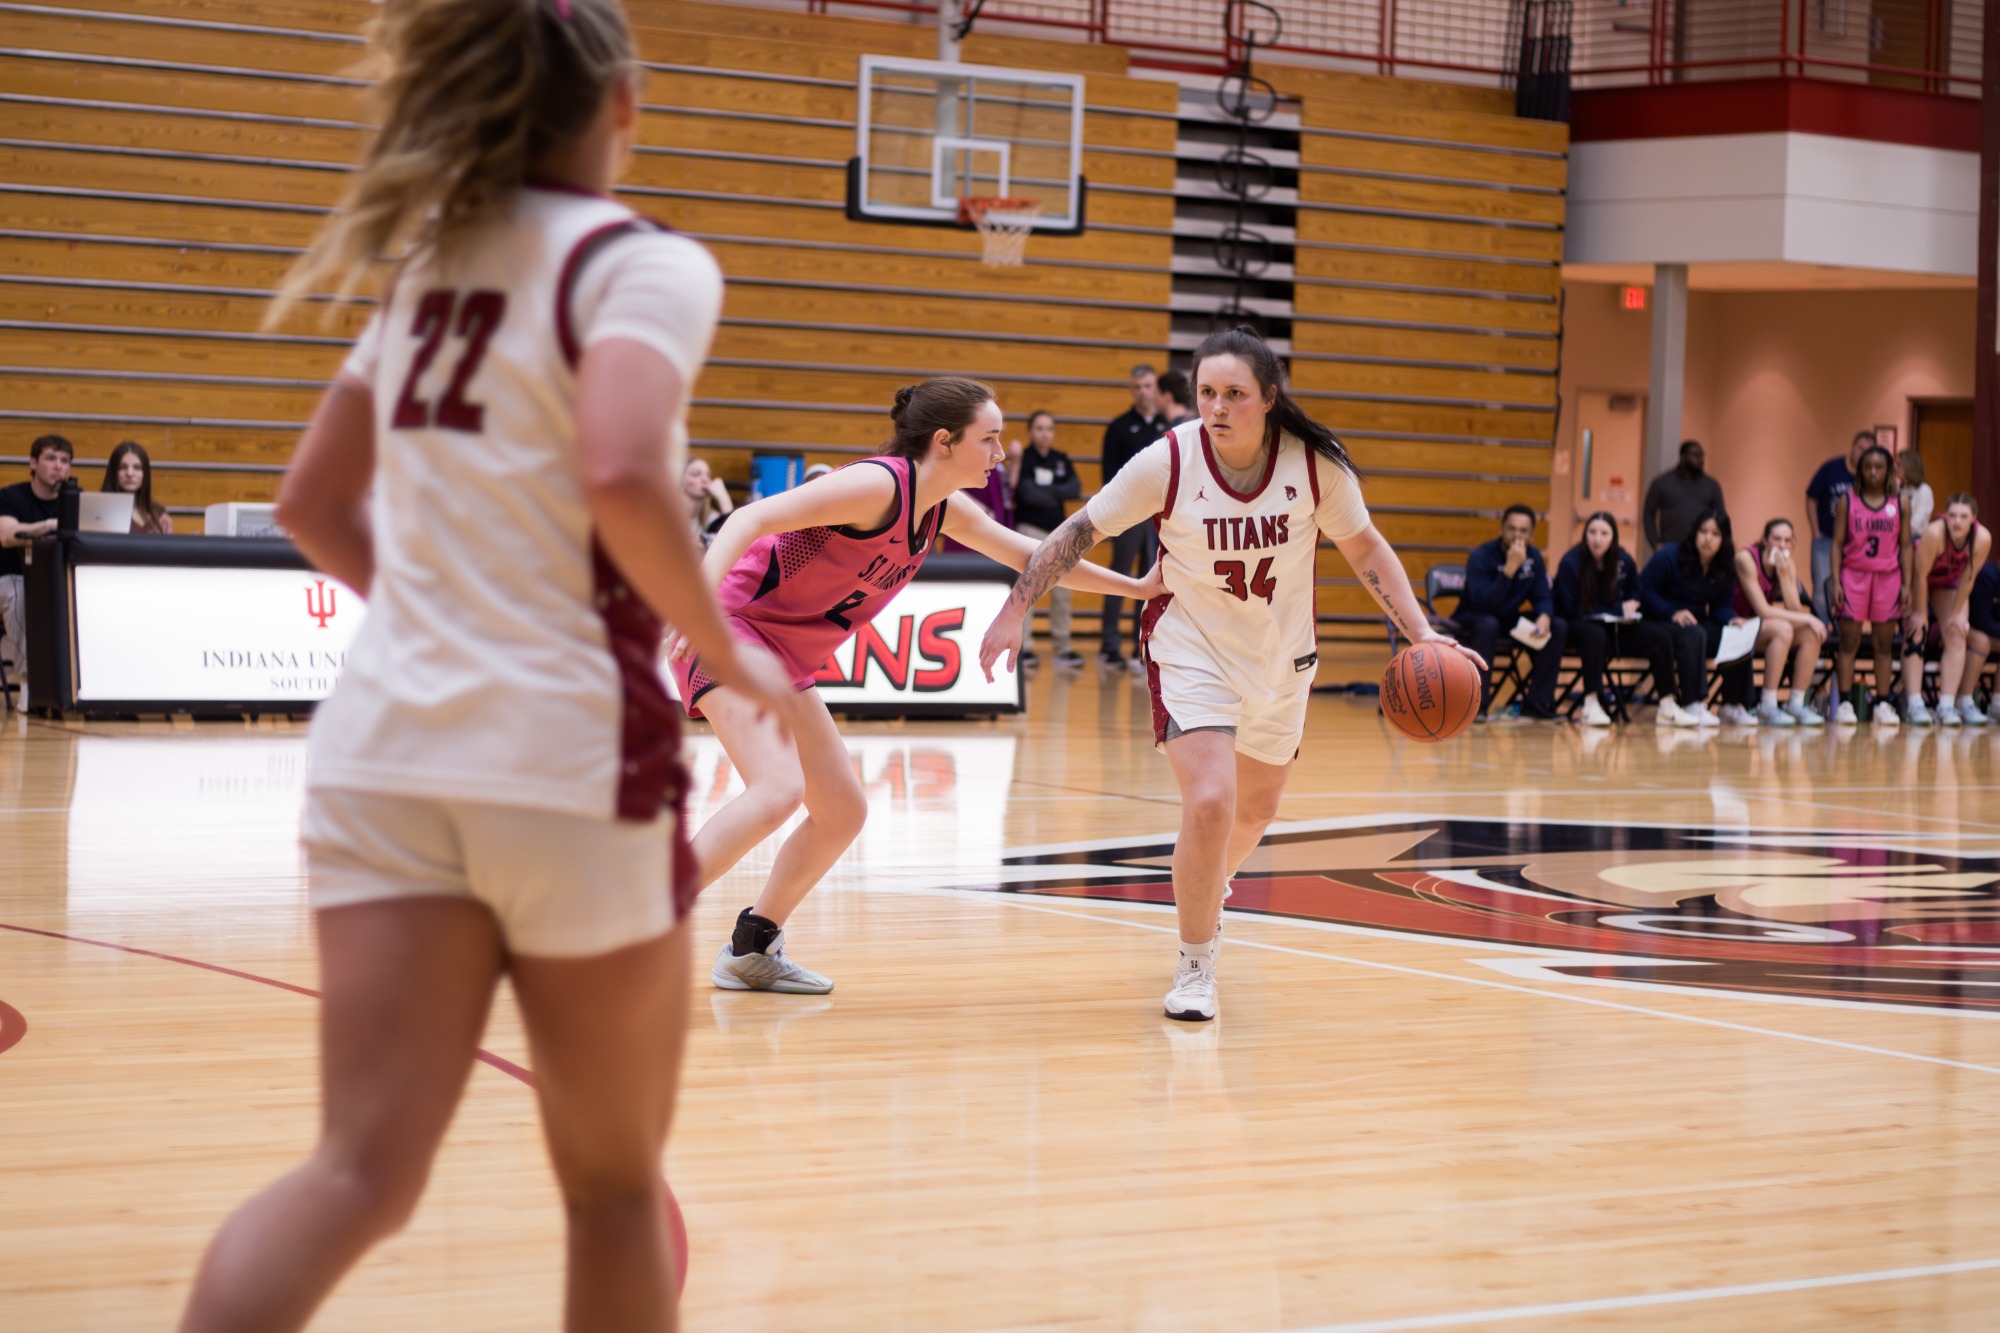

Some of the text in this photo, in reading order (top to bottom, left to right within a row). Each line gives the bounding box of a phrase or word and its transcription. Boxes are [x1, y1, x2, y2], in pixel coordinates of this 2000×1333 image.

[391, 288, 506, 434] 22
[1203, 514, 1289, 550] TITANS
[1865, 536, 1879, 558] 3
[1214, 557, 1277, 606] 34
[203, 650, 298, 668] INDIANA
[271, 677, 327, 690] SOUTH
[1410, 649, 1436, 711] SPALDING
